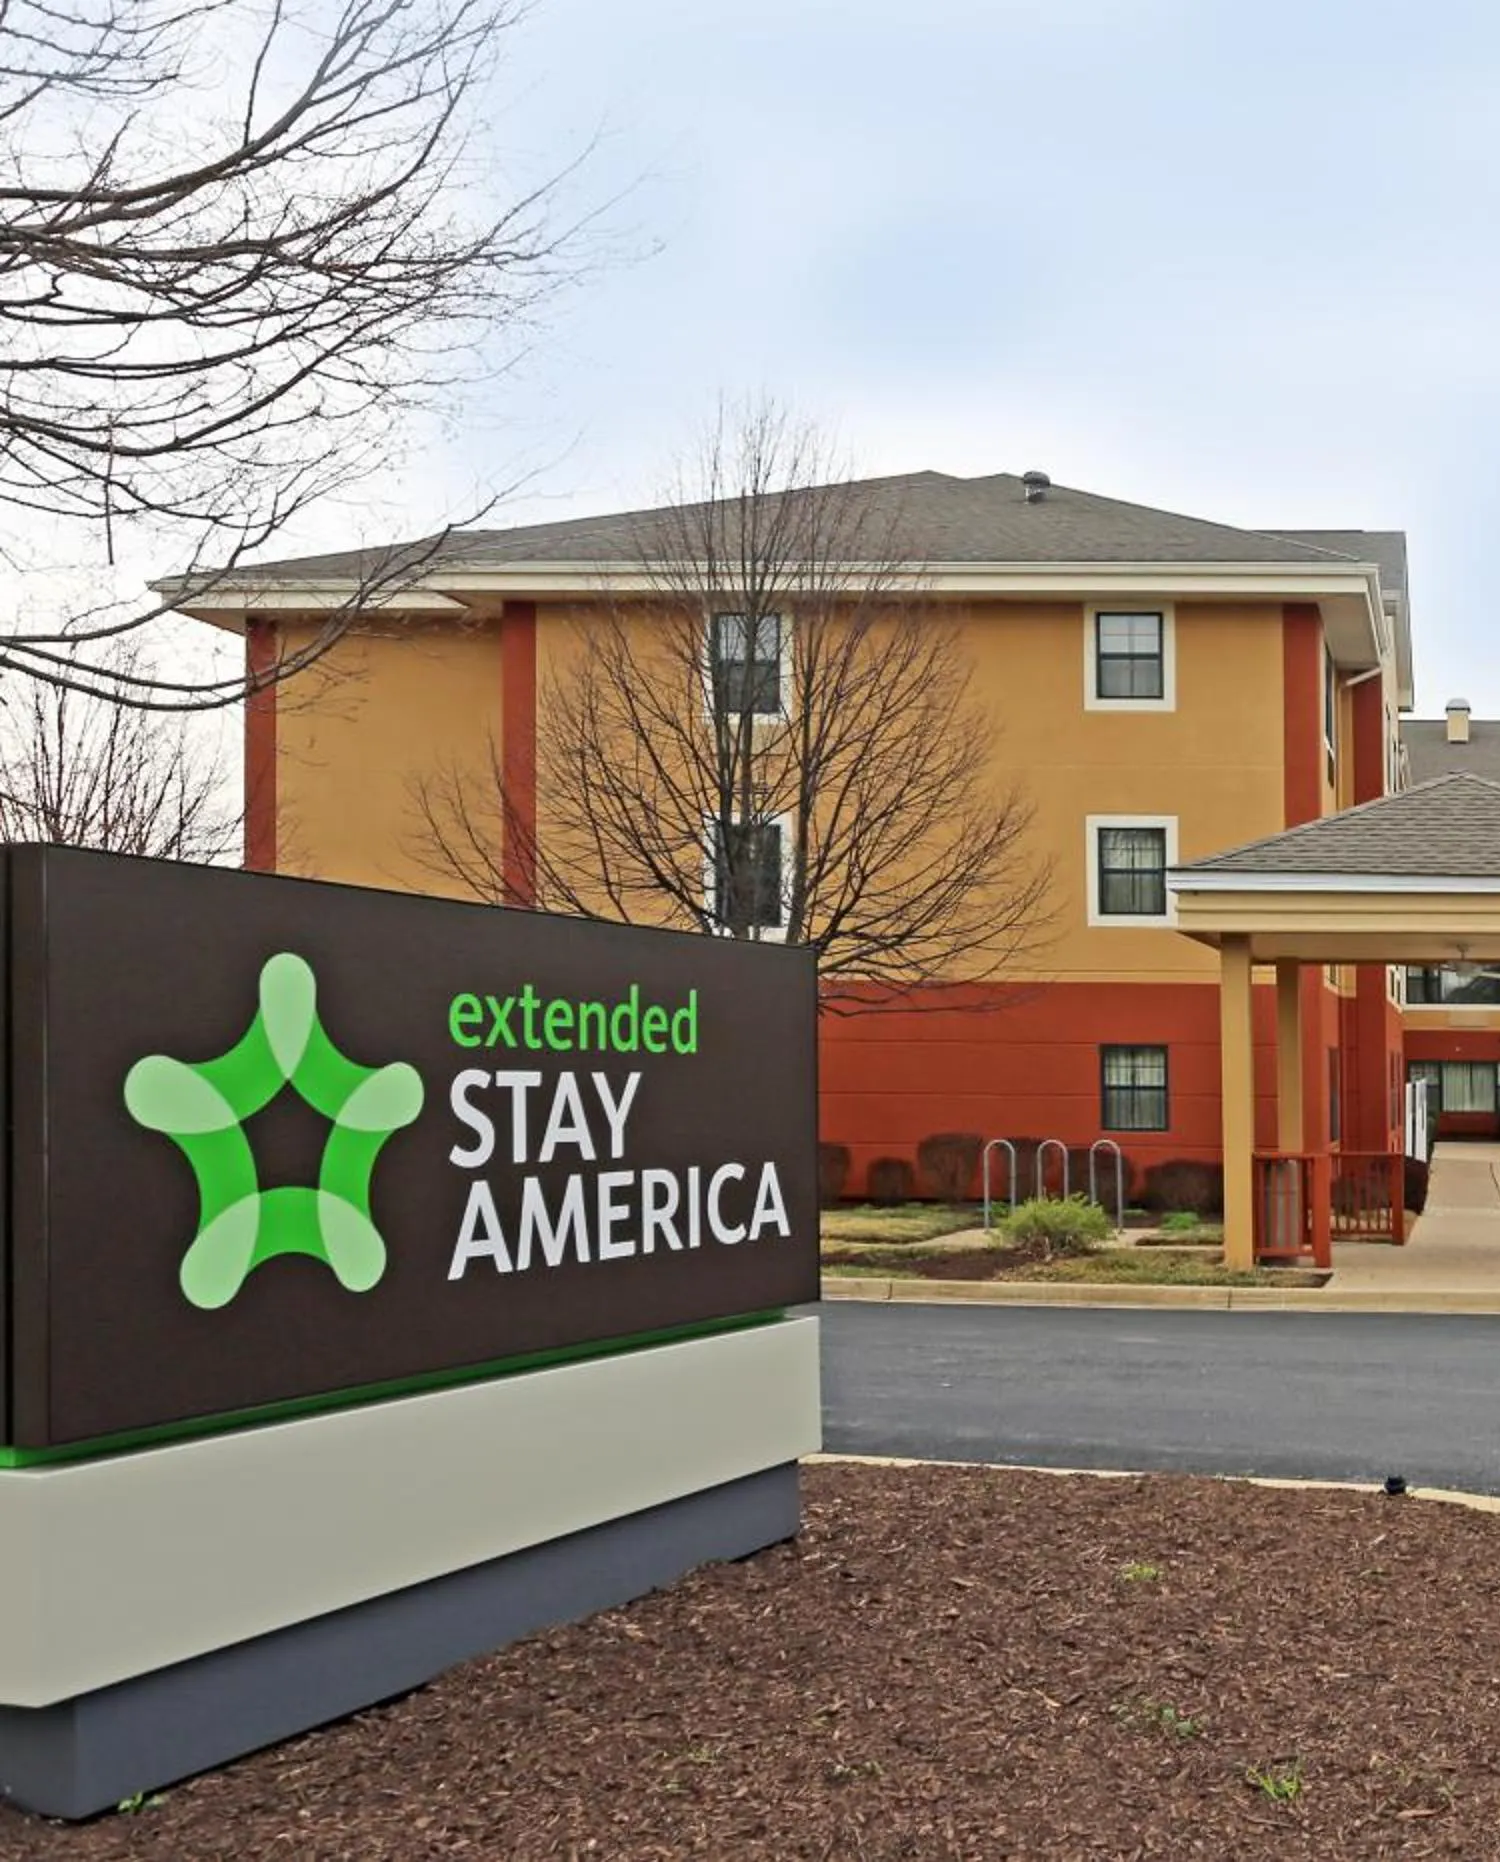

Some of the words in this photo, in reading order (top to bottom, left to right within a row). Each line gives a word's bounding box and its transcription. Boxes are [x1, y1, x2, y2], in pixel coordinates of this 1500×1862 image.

[448, 984, 698, 1053] extended
[449, 1068, 642, 1168] STAY
[447, 1162, 791, 1280] AMERICA
